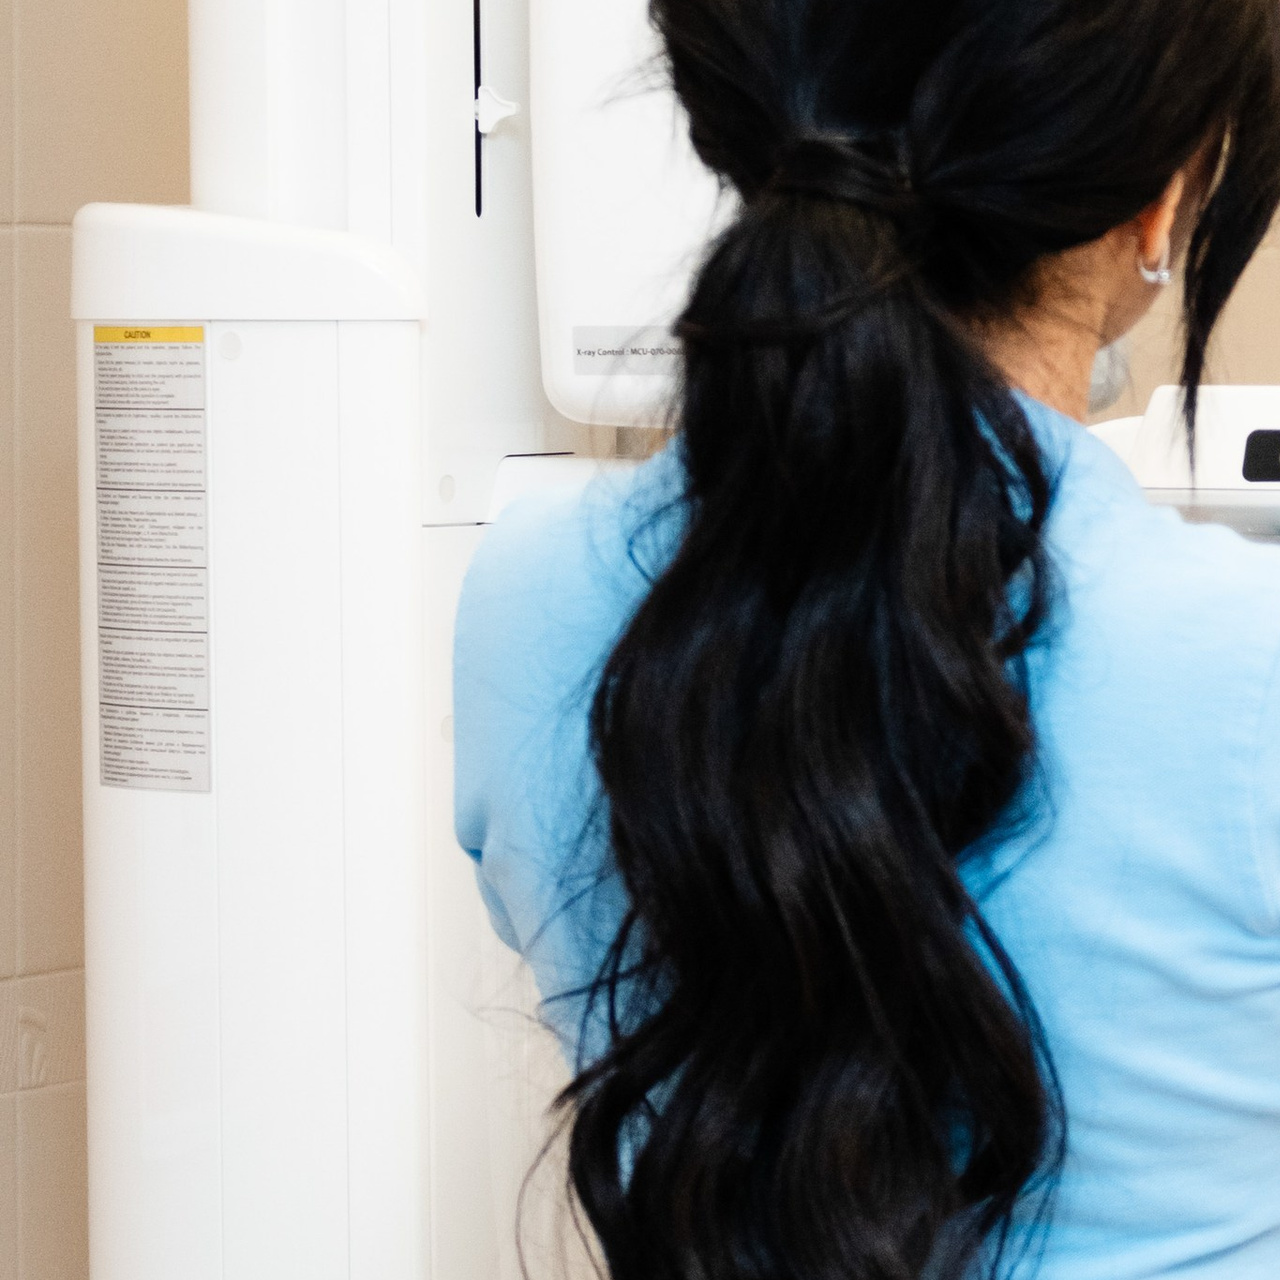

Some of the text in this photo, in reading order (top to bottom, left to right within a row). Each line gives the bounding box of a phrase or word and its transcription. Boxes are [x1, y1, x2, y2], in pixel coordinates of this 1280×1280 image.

[124, 330, 151, 338] CAUTION
[576, 349, 595, 357] X-ray
[597, 348, 624, 356] Control
